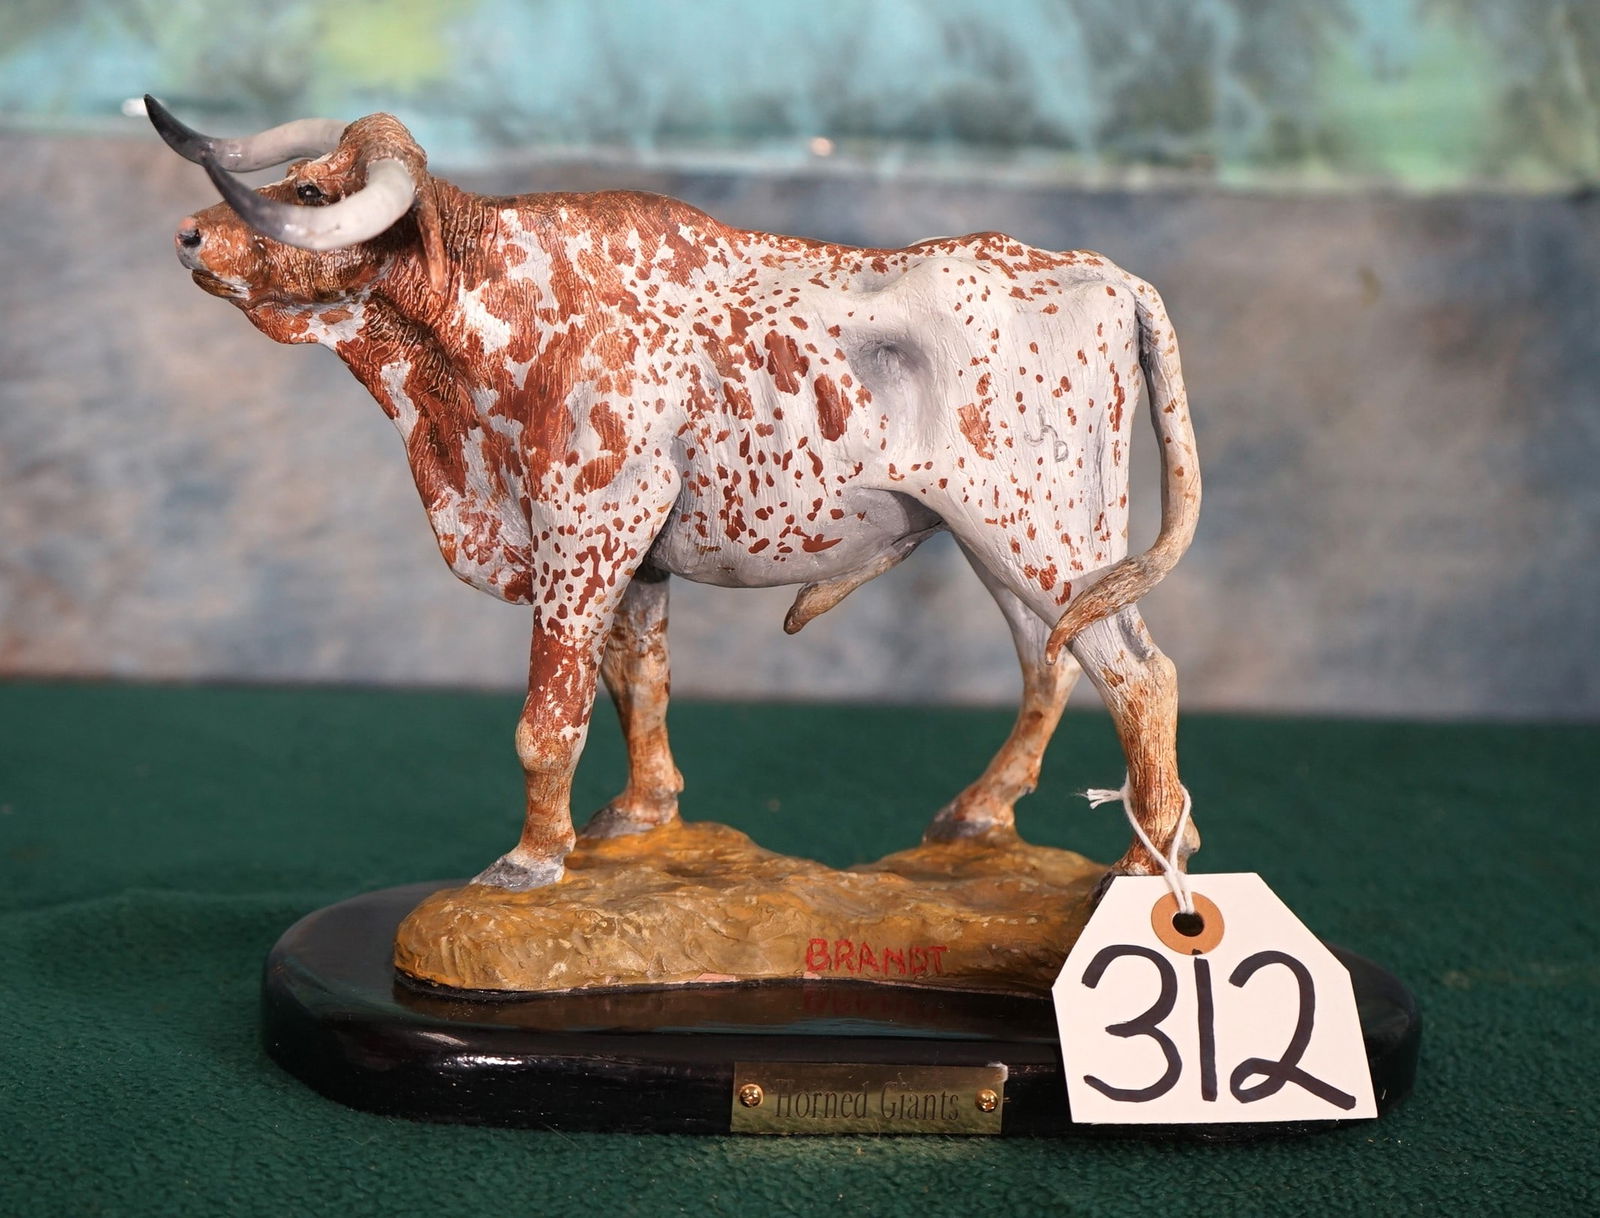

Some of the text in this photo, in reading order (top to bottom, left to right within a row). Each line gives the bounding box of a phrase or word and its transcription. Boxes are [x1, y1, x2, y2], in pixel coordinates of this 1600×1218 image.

[806, 938, 947, 975] BRANDT
[1081, 944, 1356, 1111] 312
[774, 1079, 959, 1121] Horned Giants
